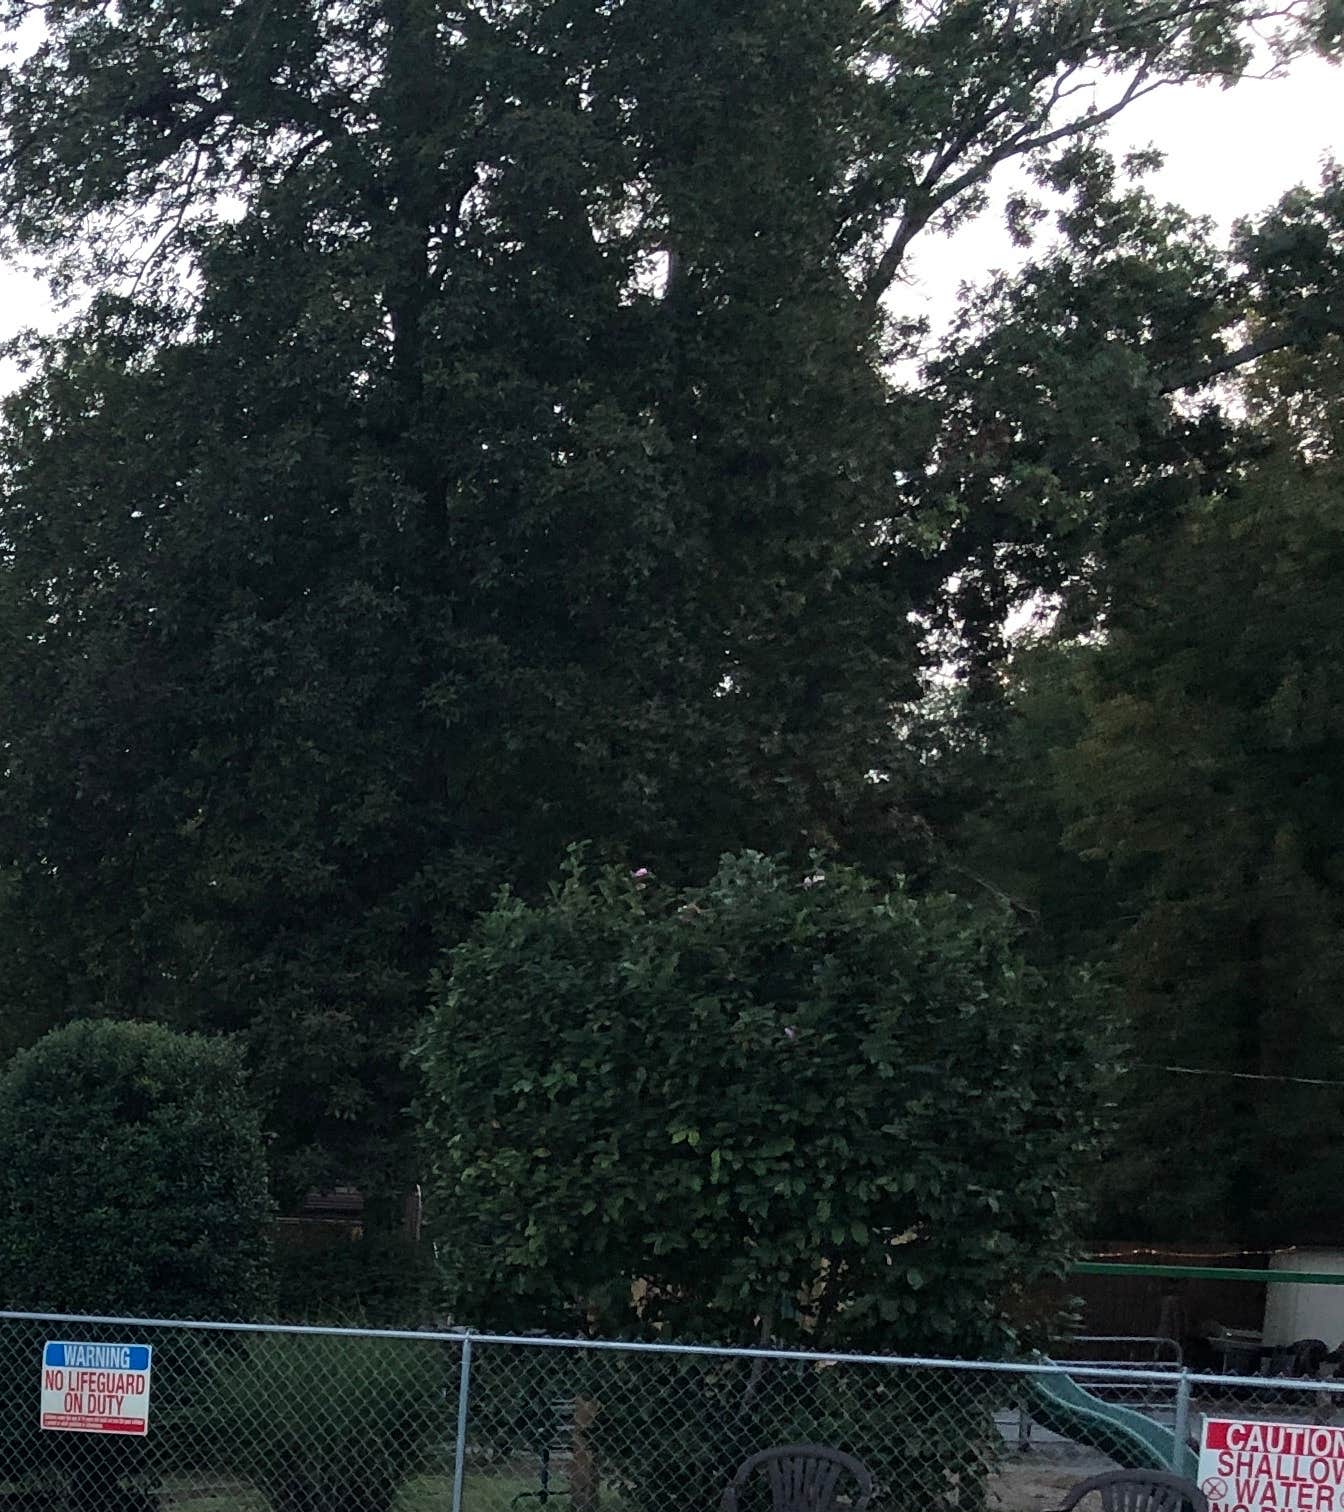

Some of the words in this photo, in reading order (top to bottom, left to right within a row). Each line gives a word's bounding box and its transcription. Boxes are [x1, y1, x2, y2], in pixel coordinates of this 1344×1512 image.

[64, 1344, 130, 1368] WARNING
[45, 1370, 64, 1391] NO
[68, 1371, 145, 1395] LIFEGUARD
[64, 1392, 83, 1413] ON
[88, 1394, 125, 1415] DUTY
[1235, 1478, 1335, 1511] WATER
